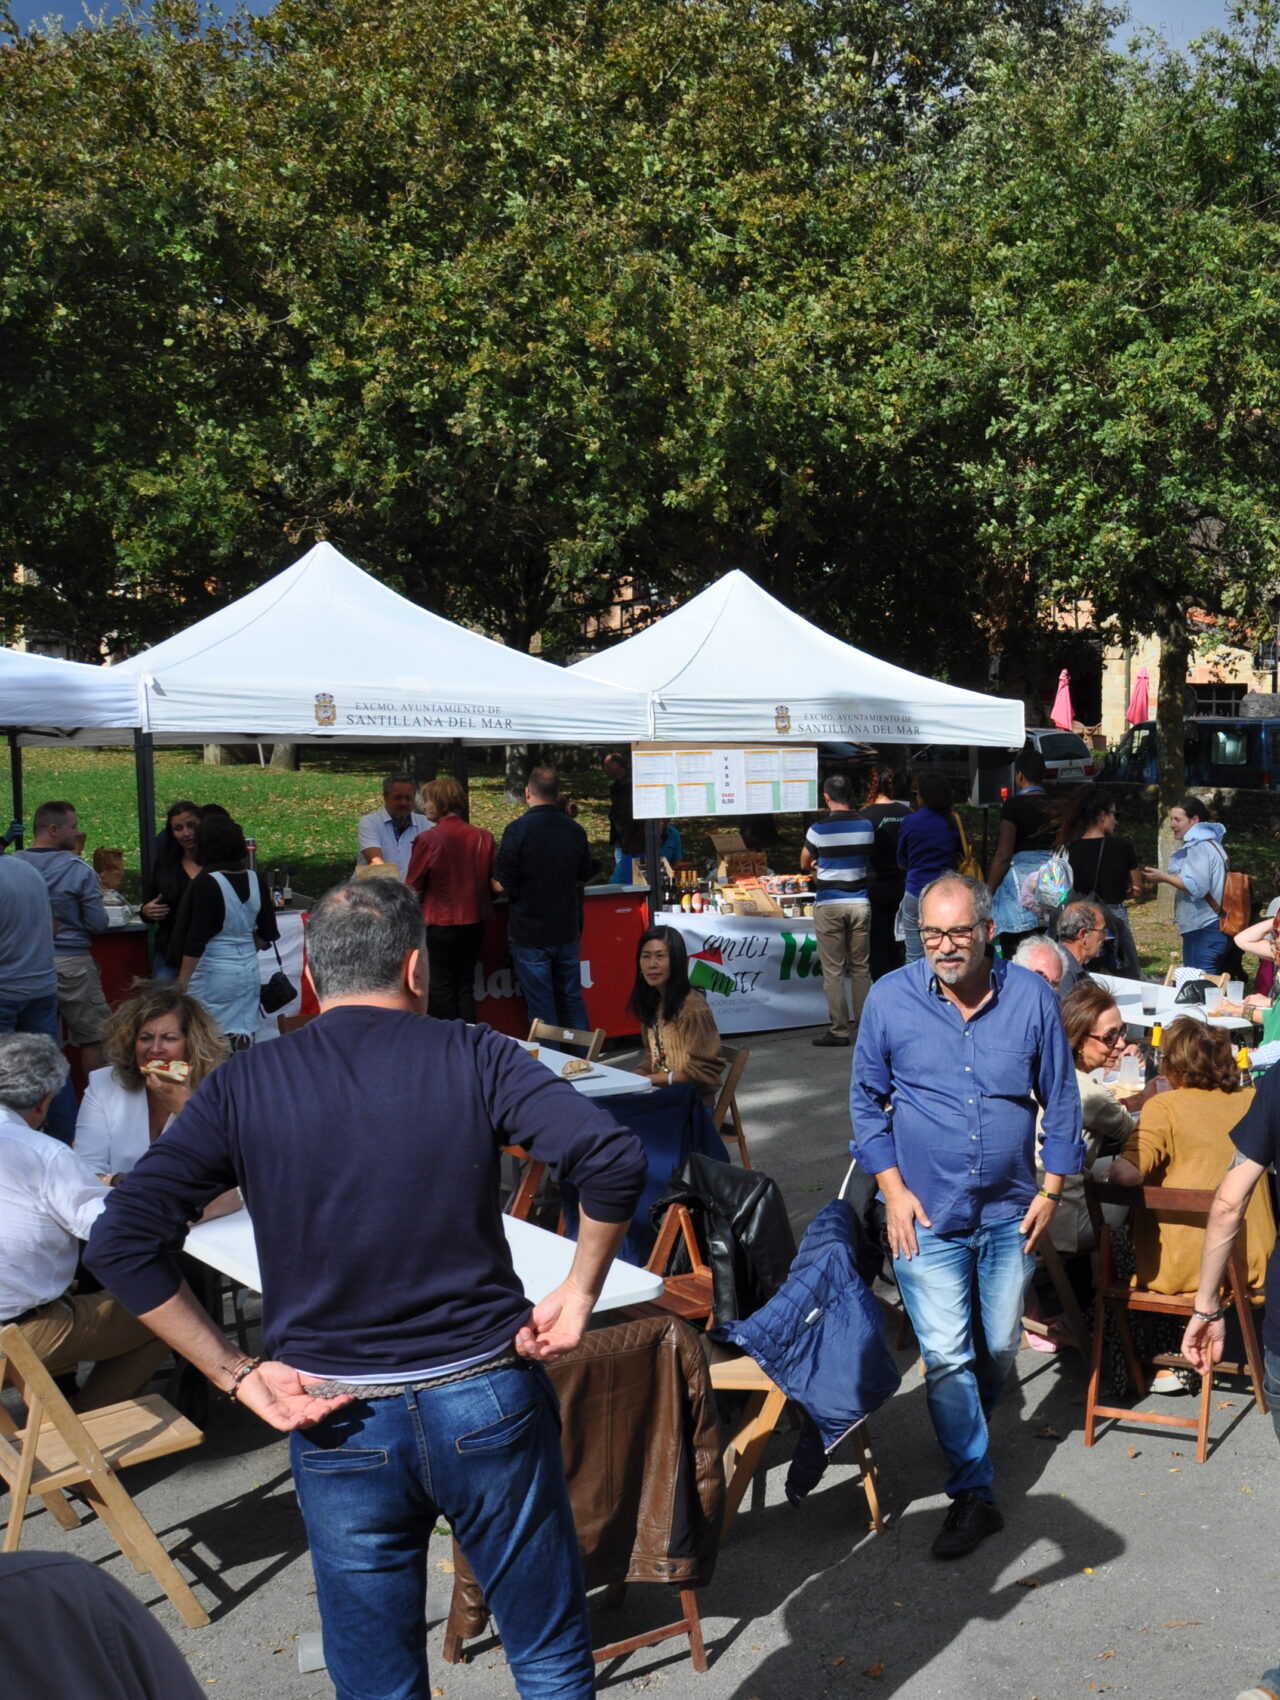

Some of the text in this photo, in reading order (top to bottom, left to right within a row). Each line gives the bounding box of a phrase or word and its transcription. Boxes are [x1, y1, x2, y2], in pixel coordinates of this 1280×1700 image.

[355, 702, 501, 714] EXCMO. AYUNTAMIENTO DE
[346, 714, 513, 729] SANTILLANA DEL MAR
[837, 714, 900, 723] AYUNTAMIENTO
[901, 715, 912, 723] DE
[798, 723, 920, 735] SANTILLANA DEL MAR
